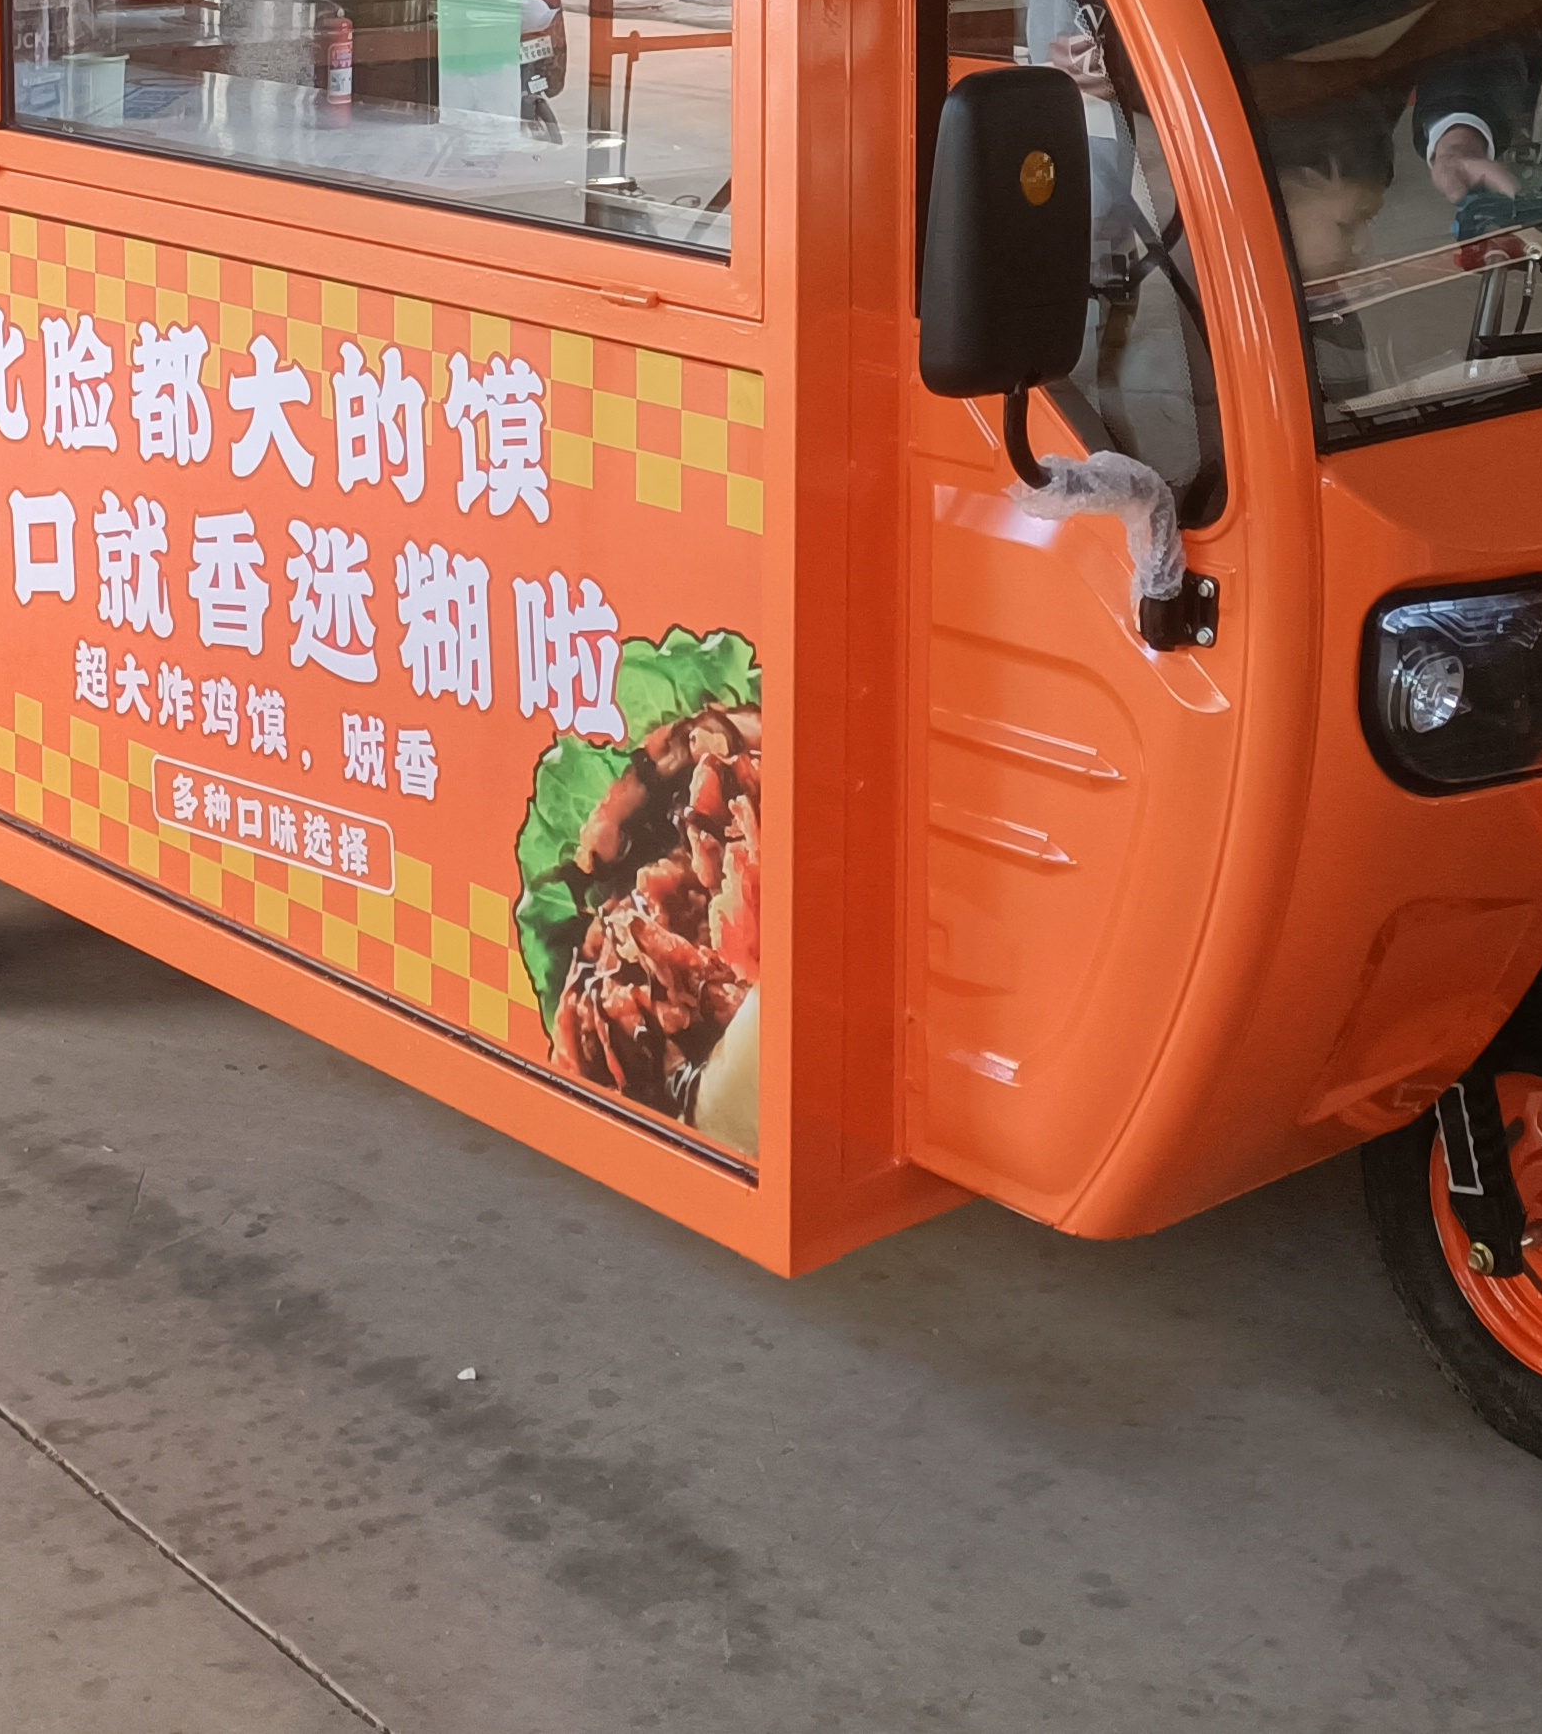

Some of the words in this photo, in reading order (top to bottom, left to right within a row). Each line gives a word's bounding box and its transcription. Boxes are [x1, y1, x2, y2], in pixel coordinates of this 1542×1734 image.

[171, 774, 371, 877] 多种口味选择
